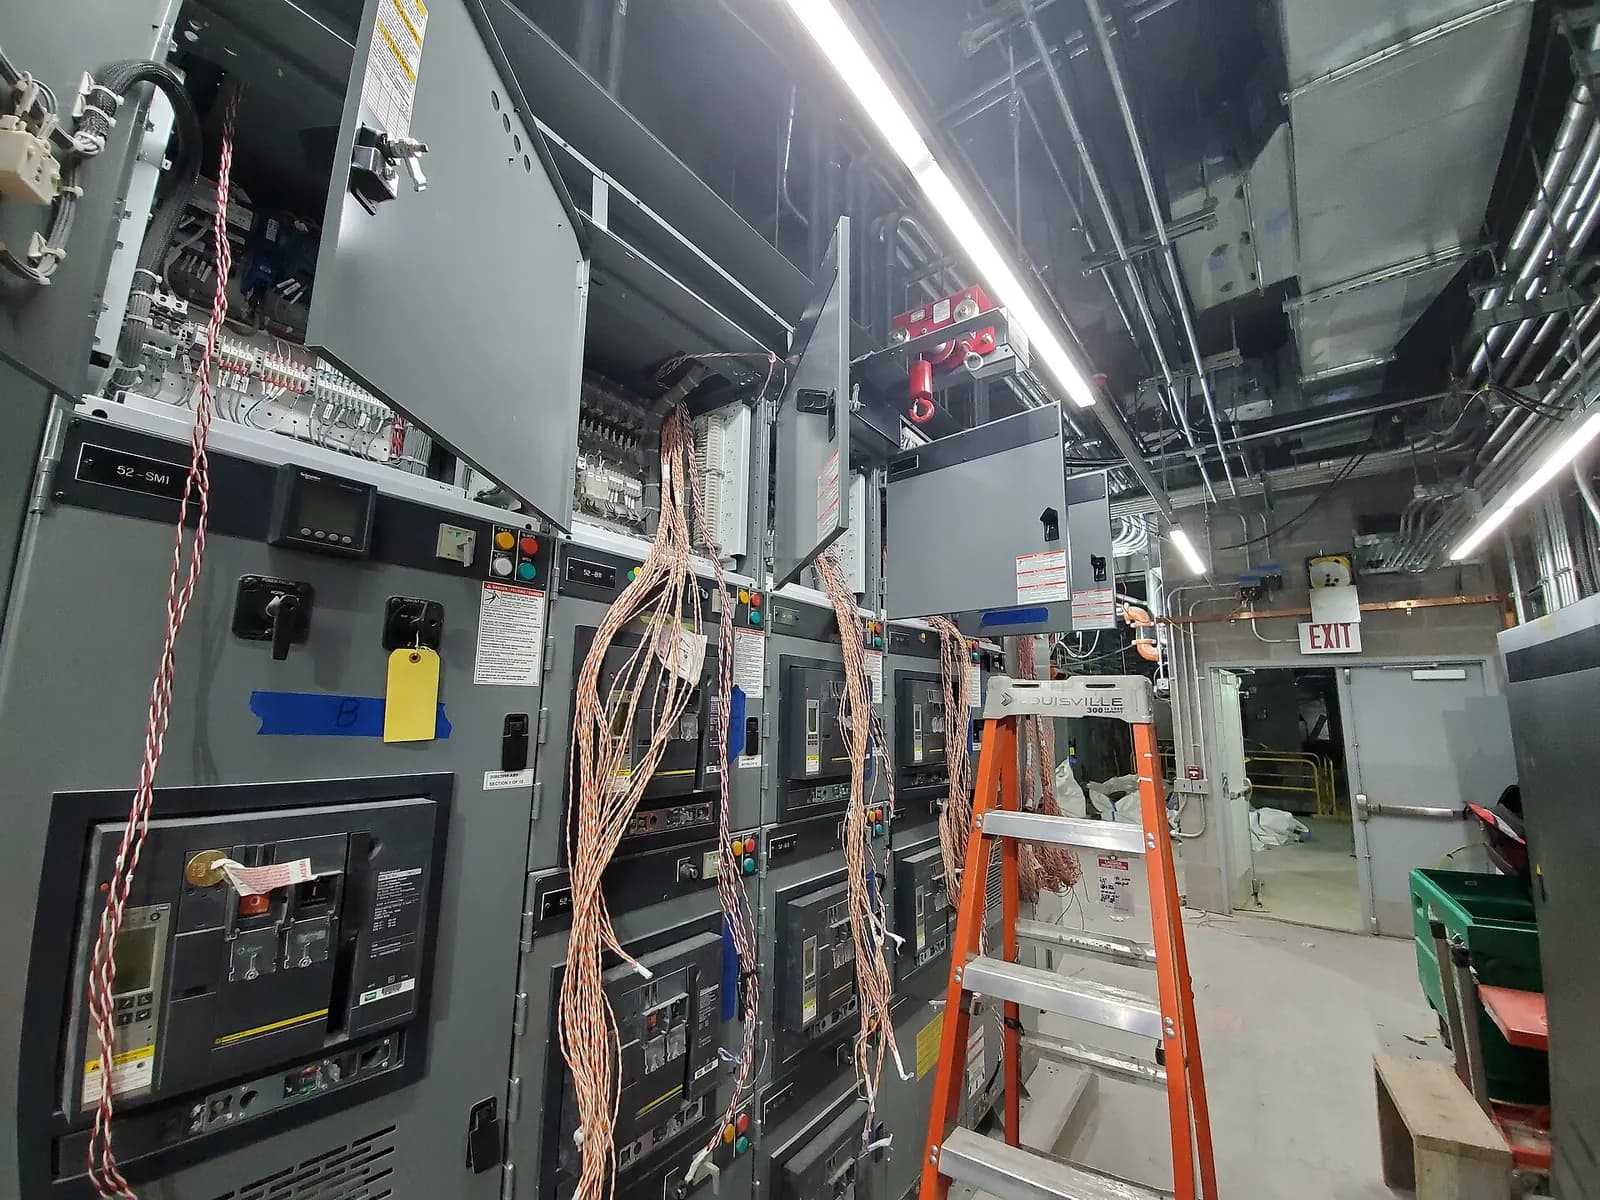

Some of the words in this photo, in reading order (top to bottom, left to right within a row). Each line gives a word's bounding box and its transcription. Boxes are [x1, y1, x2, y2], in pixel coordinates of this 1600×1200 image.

[1309, 623, 1350, 649] EXIT
[336, 698, 360, 727] B
[1087, 706, 1103, 714] 300
